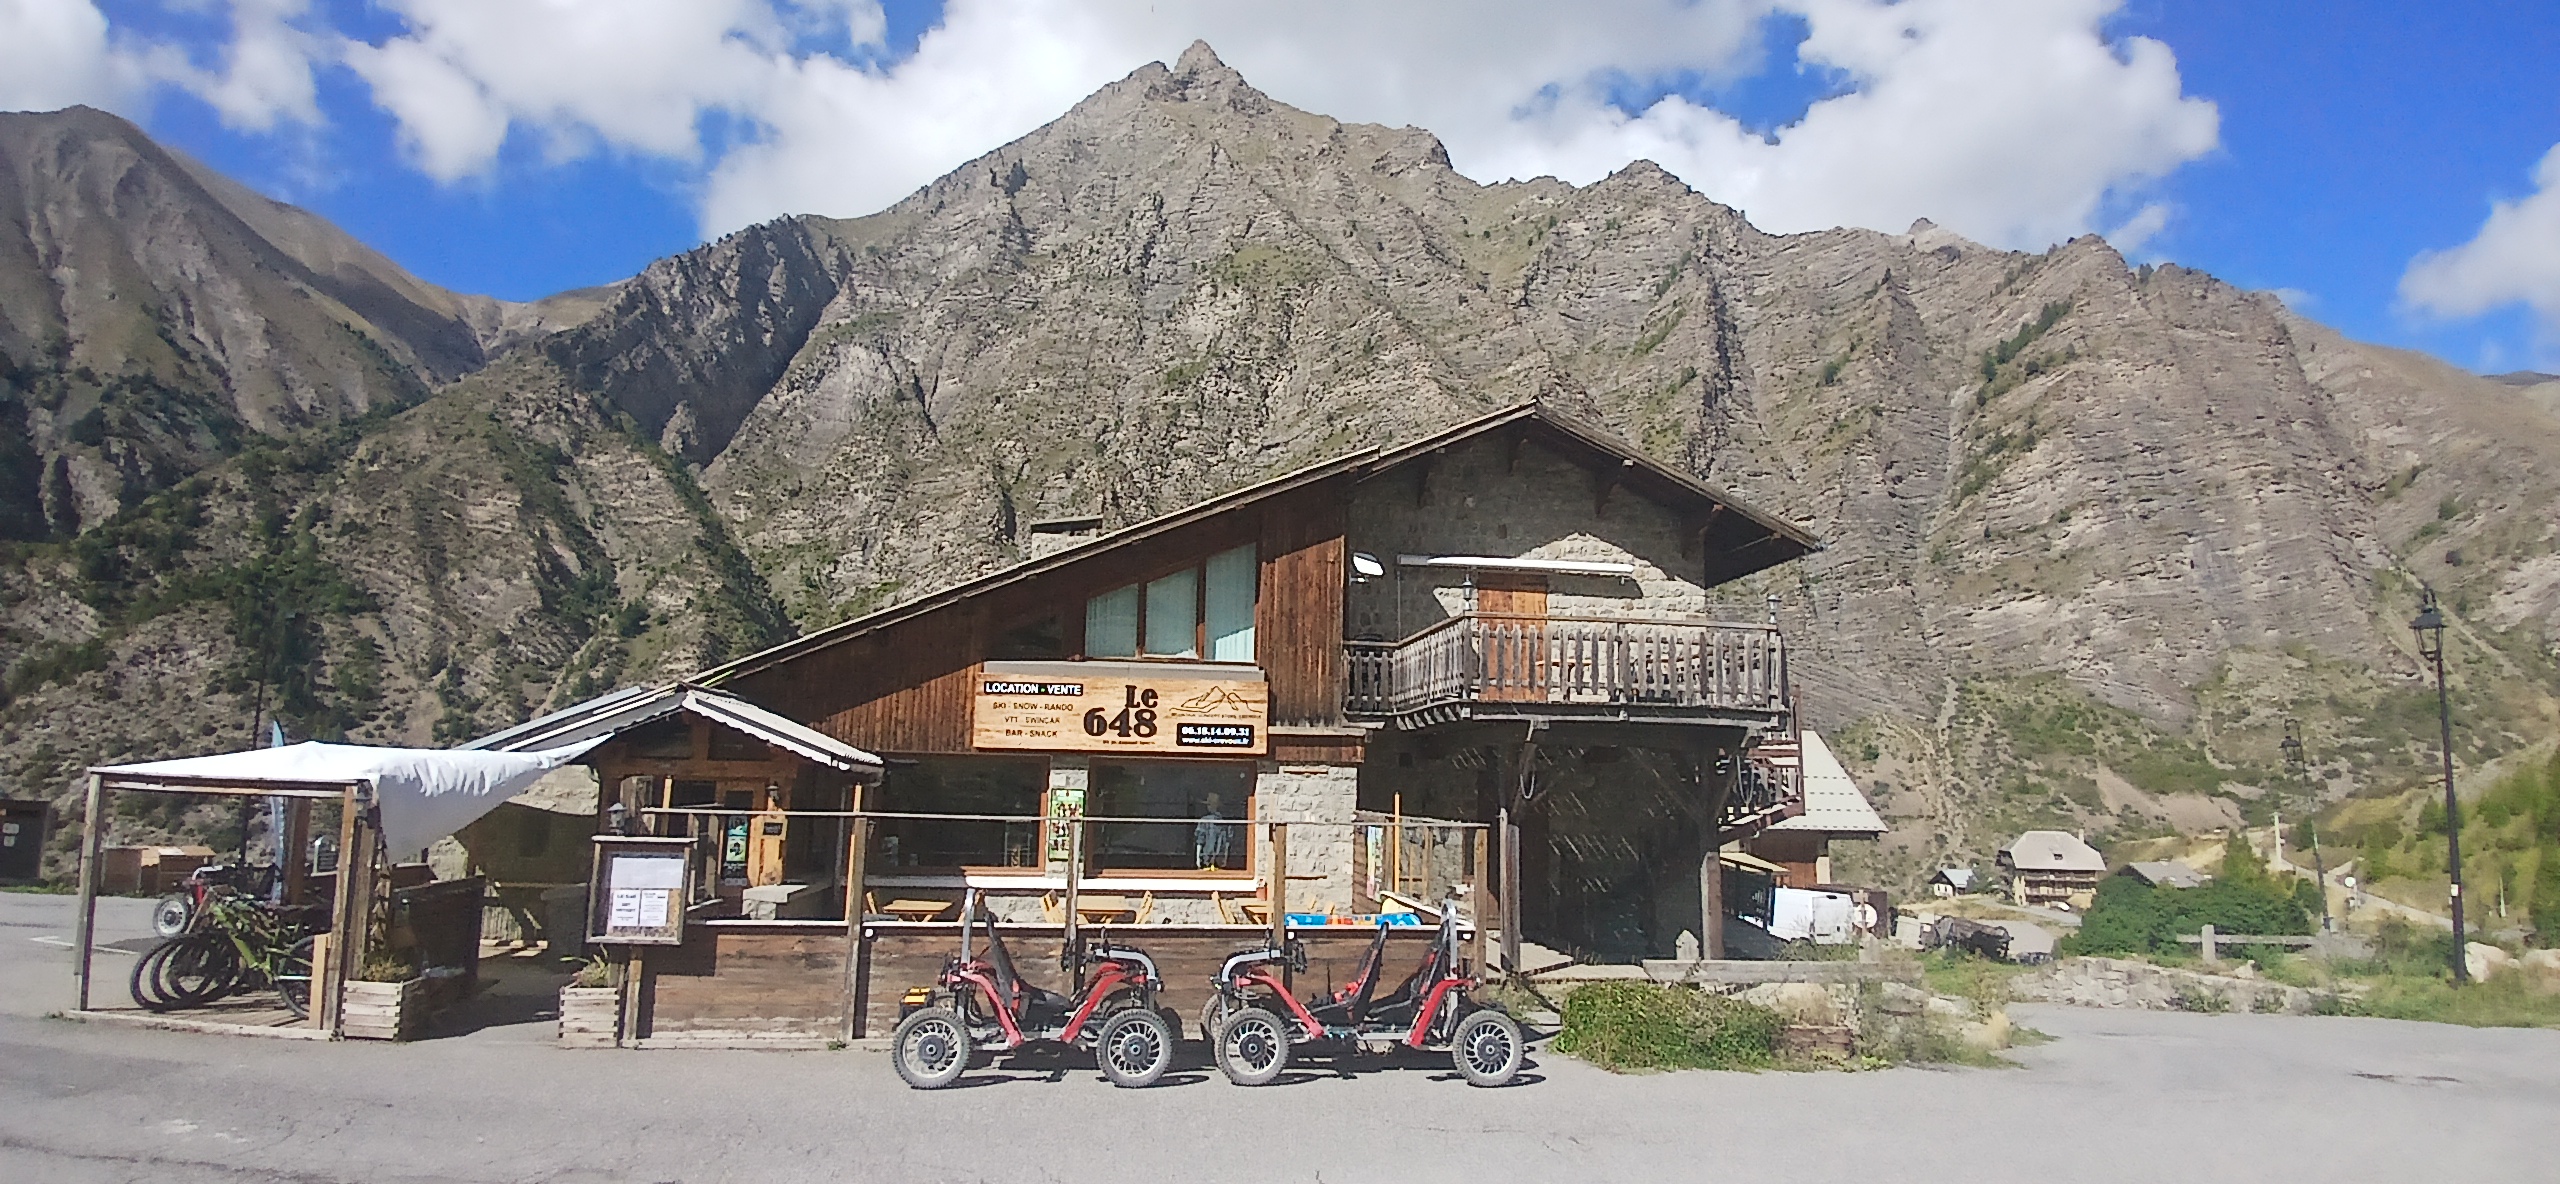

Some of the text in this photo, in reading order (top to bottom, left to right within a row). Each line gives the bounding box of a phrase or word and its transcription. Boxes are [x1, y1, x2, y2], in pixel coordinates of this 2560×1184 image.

[985, 682, 1039, 694] LOCATION
[1046, 684, 1082, 696] VENTE
[1124, 684, 1159, 709] Le
[992, 701, 1007, 710] SKI
[1013, 702, 1038, 710] SNOW
[1044, 703, 1074, 712] RANDO
[1083, 706, 1158, 739] 648
[1005, 729, 1023, 737] BAR
[1029, 729, 1058, 738] SNACK
